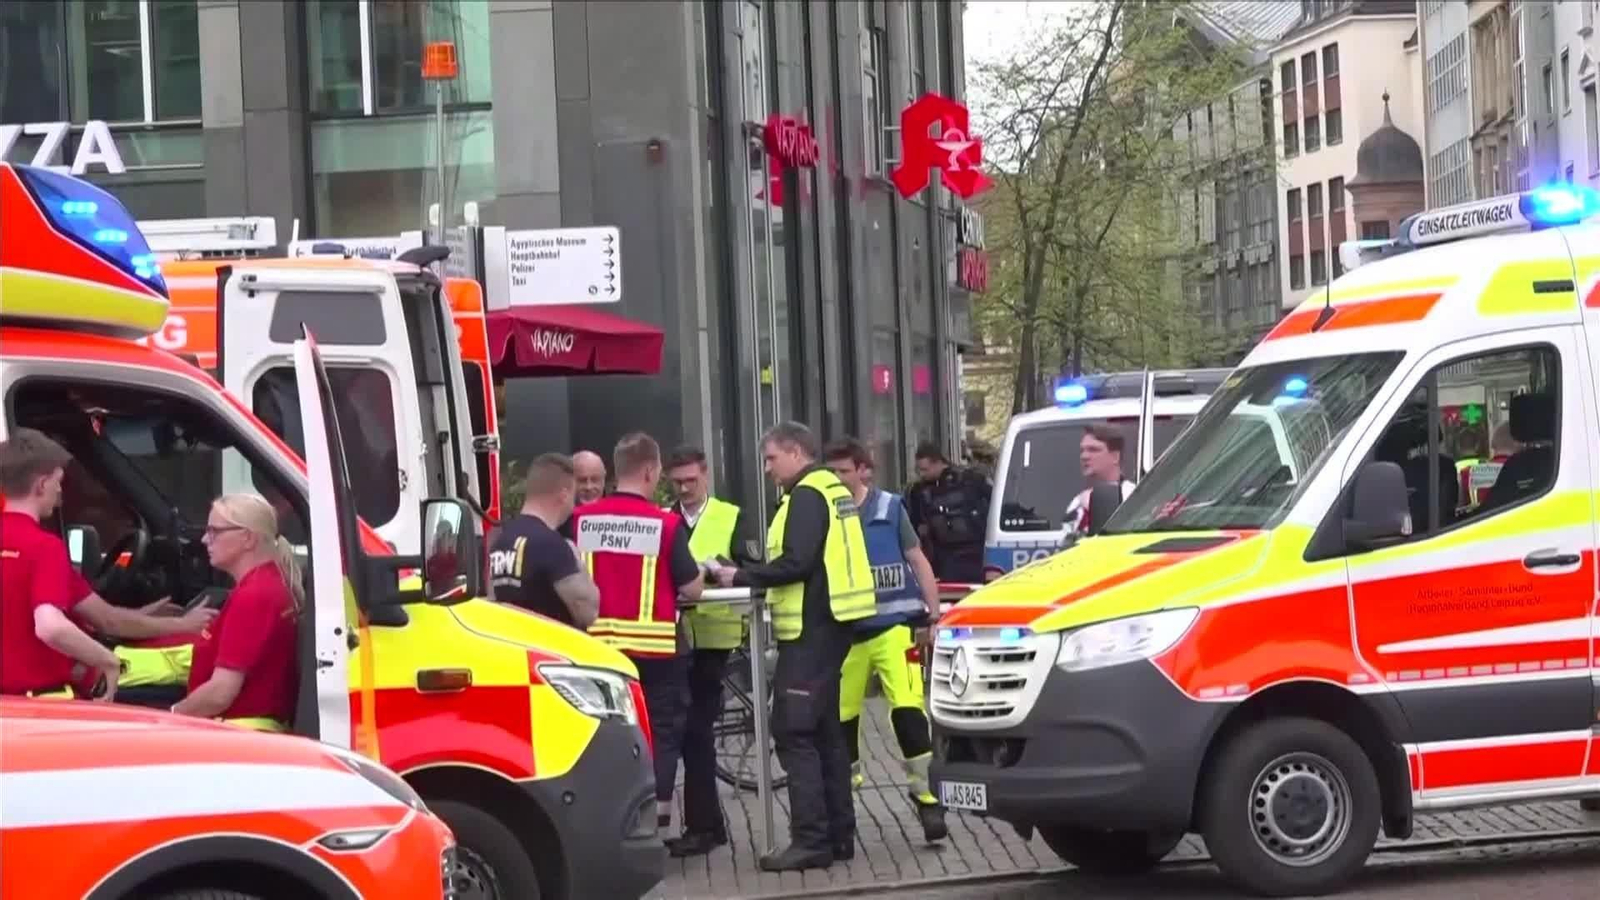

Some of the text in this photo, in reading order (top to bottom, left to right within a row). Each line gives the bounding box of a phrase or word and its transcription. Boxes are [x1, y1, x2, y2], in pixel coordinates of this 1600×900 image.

[1418, 203, 1514, 236] EINSATZLEITWAGEN
[510, 236, 587, 250] Ägyptisches Museum
[510, 249, 561, 261] Hauptbahnhof
[511, 262, 535, 273] Polizei
[512, 275, 527, 286] Taxi
[530, 328, 574, 358] VAPIANO
[580, 519, 659, 534] Gruppenführer
[600, 533, 632, 549] PSNV
